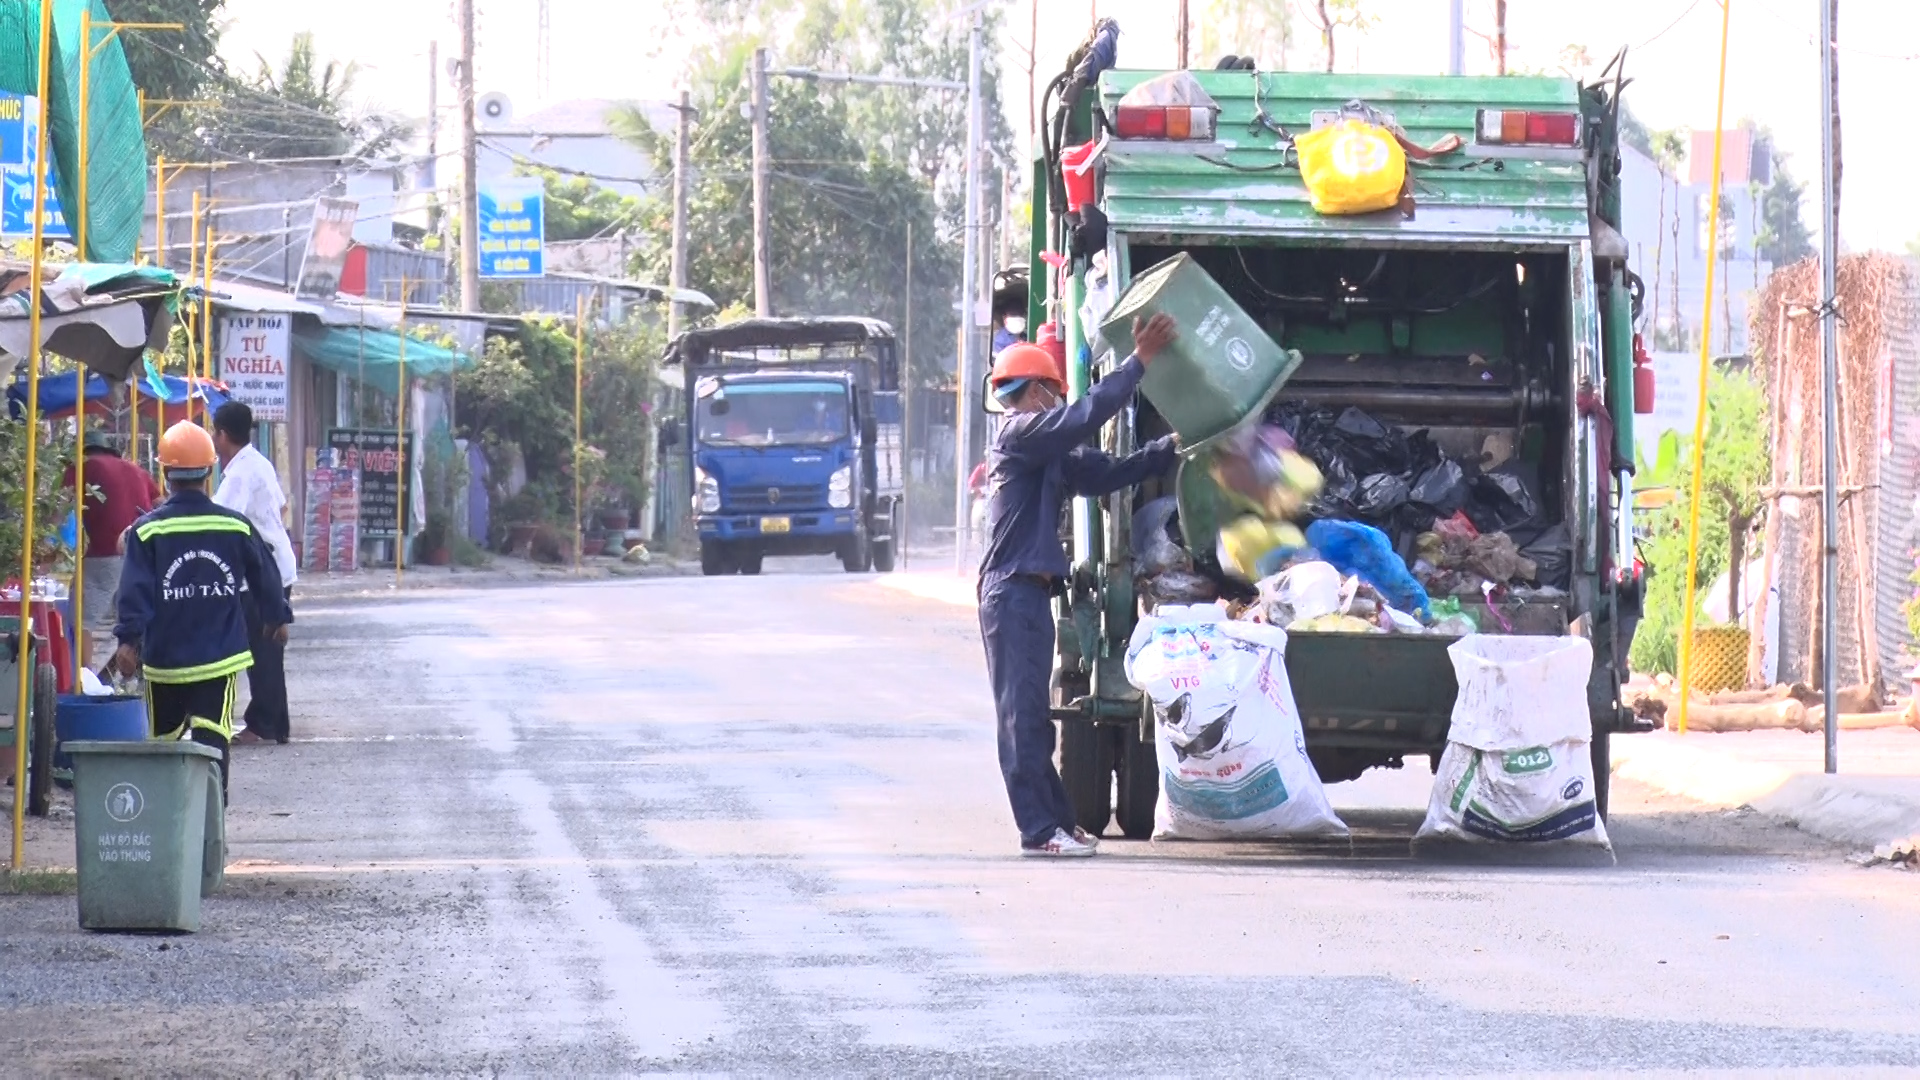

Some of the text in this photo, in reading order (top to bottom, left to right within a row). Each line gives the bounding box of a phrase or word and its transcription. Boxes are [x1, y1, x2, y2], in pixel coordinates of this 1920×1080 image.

[229, 316, 284, 331] TẠP HÓA
[224, 355, 285, 375] NGHĨA
[1170, 675, 1200, 690] VTG
